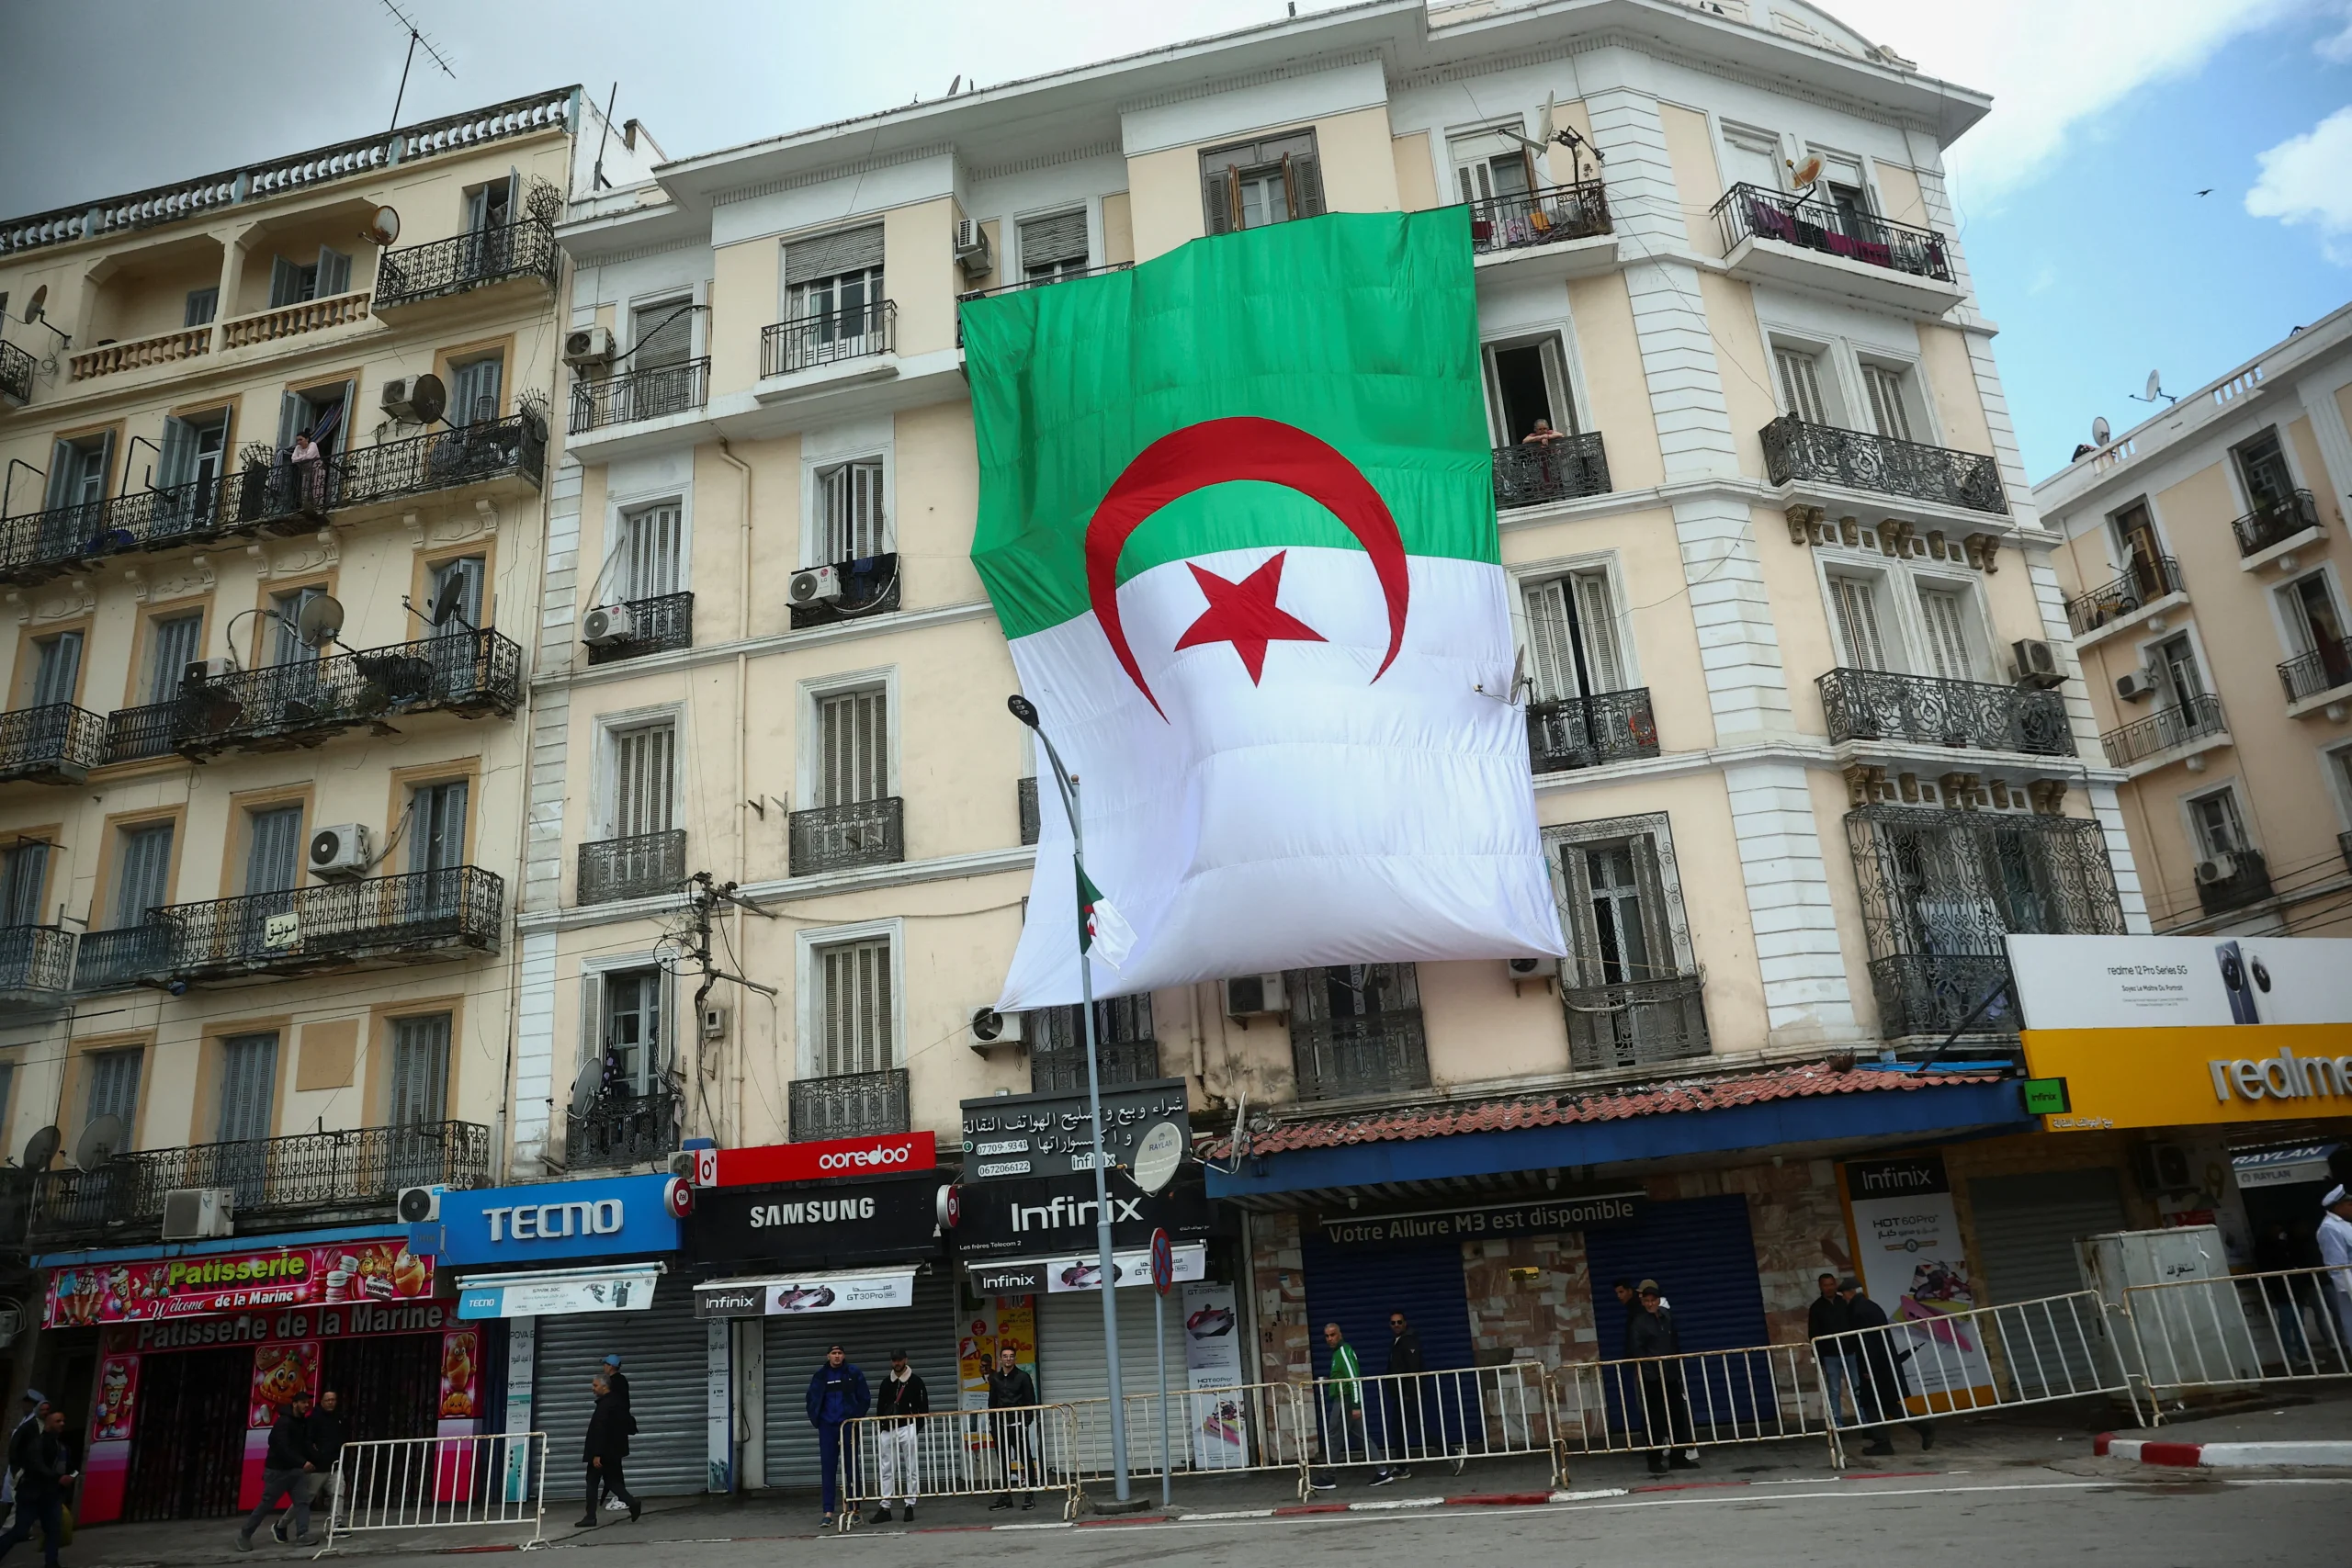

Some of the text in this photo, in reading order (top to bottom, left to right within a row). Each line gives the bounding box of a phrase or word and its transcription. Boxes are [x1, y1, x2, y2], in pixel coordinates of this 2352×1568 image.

[2108, 965, 2188, 975] realme 12 Pro Series 5G
[1152, 1097, 1183, 1113] شراء
[963, 1116, 1001, 1134] النقالة
[1005, 1111, 1057, 1133] الهواتف
[1148, 1139, 1173, 1151] RAYLAN
[819, 1143, 912, 1169] ooredoo
[1072, 1154, 1115, 1168] infiix
[2232, 1146, 2324, 1165] RAYLAN
[979, 1162, 1029, 1175] 0672066122
[2254, 1170, 2291, 1180] RAYLAN
[1861, 1166, 1932, 1190] Infinix
[482, 1199, 623, 1242] TECNO
[750, 1197, 876, 1228] SAMSUNG
[1329, 1199, 1634, 1243] Votre Allure M3 est disponible
[1872, 1218, 1900, 1228] HOT
[169, 1252, 305, 1286] Patisserie
[983, 1273, 1035, 1290] Infinix
[214, 1289, 294, 1308] de la Marine
[469, 1298, 495, 1307] TECNO
[706, 1294, 753, 1309] Infinix
[147, 1297, 205, 1320] Welcome
[277, 1309, 308, 1338] de
[316, 1306, 341, 1335] la
[350, 1302, 443, 1333] Marine
